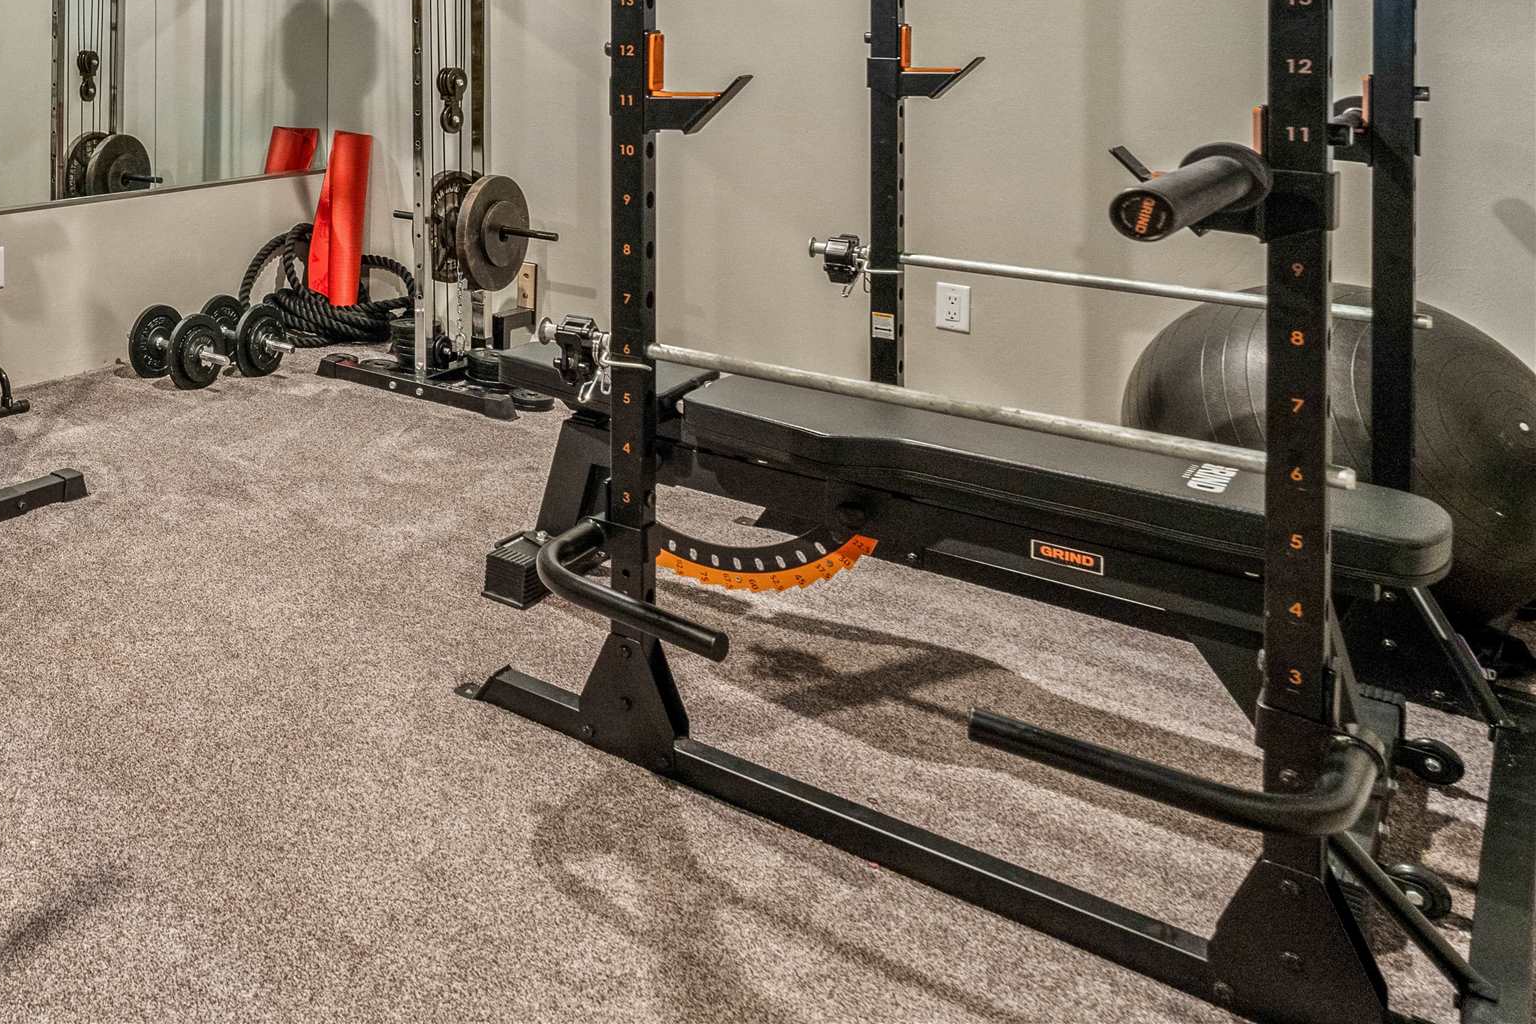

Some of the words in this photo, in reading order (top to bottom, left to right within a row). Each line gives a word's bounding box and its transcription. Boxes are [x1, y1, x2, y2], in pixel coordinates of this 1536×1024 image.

[620, 45, 635, 57] 12
[1286, 58, 1313, 74] 12
[620, 95, 634, 107] 11
[1286, 127, 1310, 143] 11
[620, 144, 635, 156] 10
[623, 194, 631, 206] 9
[1135, 197, 1155, 235] GRIND
[623, 244, 631, 255] 8
[1292, 262, 1304, 277] 9
[623, 293, 631, 304] 7
[1290, 331, 1304, 346] 8
[623, 344, 631, 356] 6
[623, 392, 631, 404] 5
[1291, 398, 1304, 414] 7
[622, 443, 631, 454] 4
[1290, 466, 1303, 481] 6
[623, 492, 631, 504] 3
[1290, 534, 1303, 550] 5
[1039, 545, 1095, 568] GRIND
[1289, 601, 1303, 617] 4
[1289, 669, 1302, 685] 3
